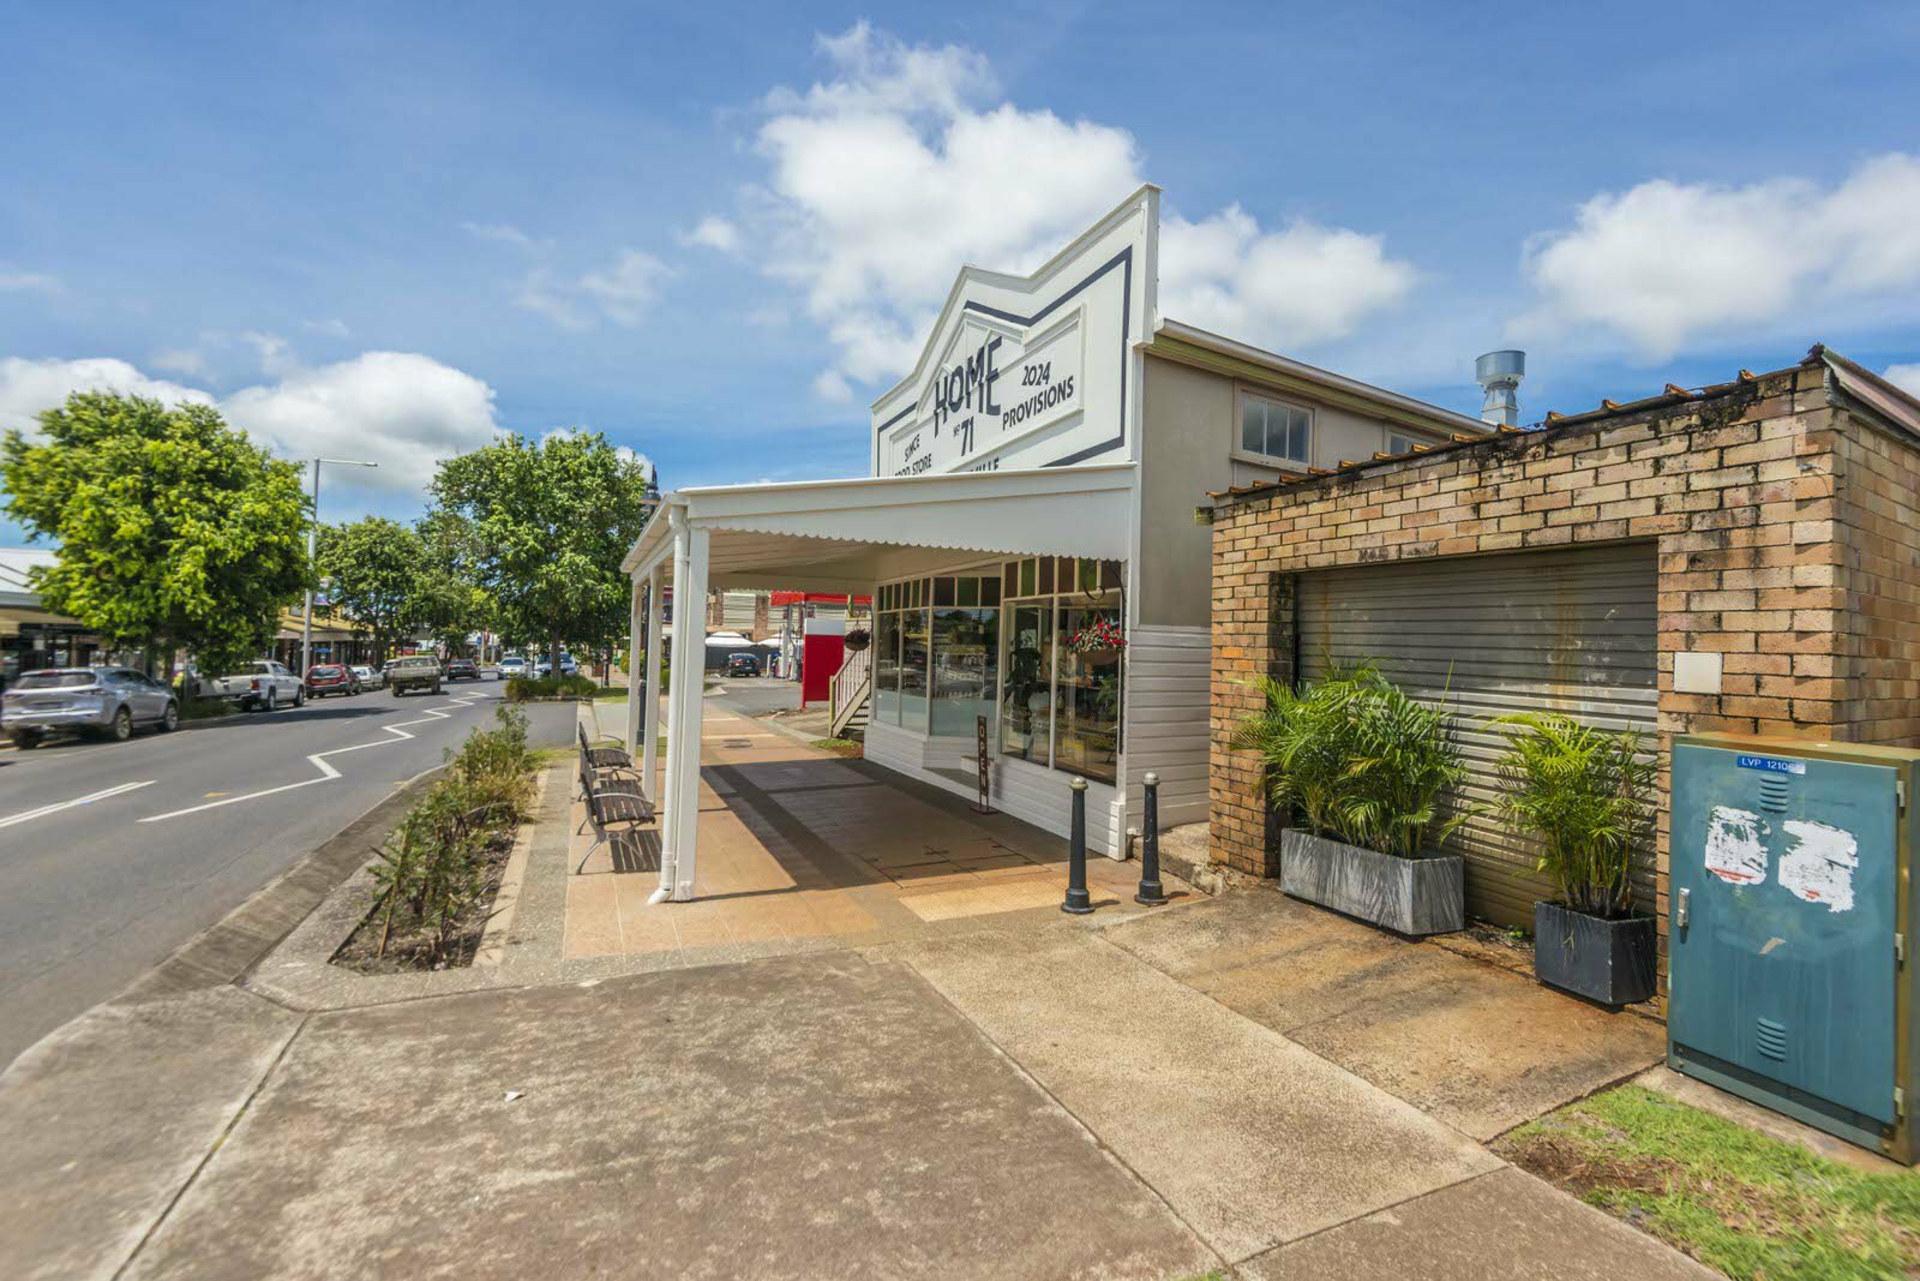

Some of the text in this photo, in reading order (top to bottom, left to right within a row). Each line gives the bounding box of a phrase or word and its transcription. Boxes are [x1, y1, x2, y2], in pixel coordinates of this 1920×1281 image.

[934, 335, 1002, 438] HOME
[1021, 361, 1051, 386] 2024
[1002, 375, 1074, 431] PROVISIONS
[904, 433, 920, 463] SINCE
[961, 416, 974, 457] 71
[912, 453, 932, 475] STORE
[979, 725, 987, 787] OPEN
[1741, 757, 1762, 767] LVP
